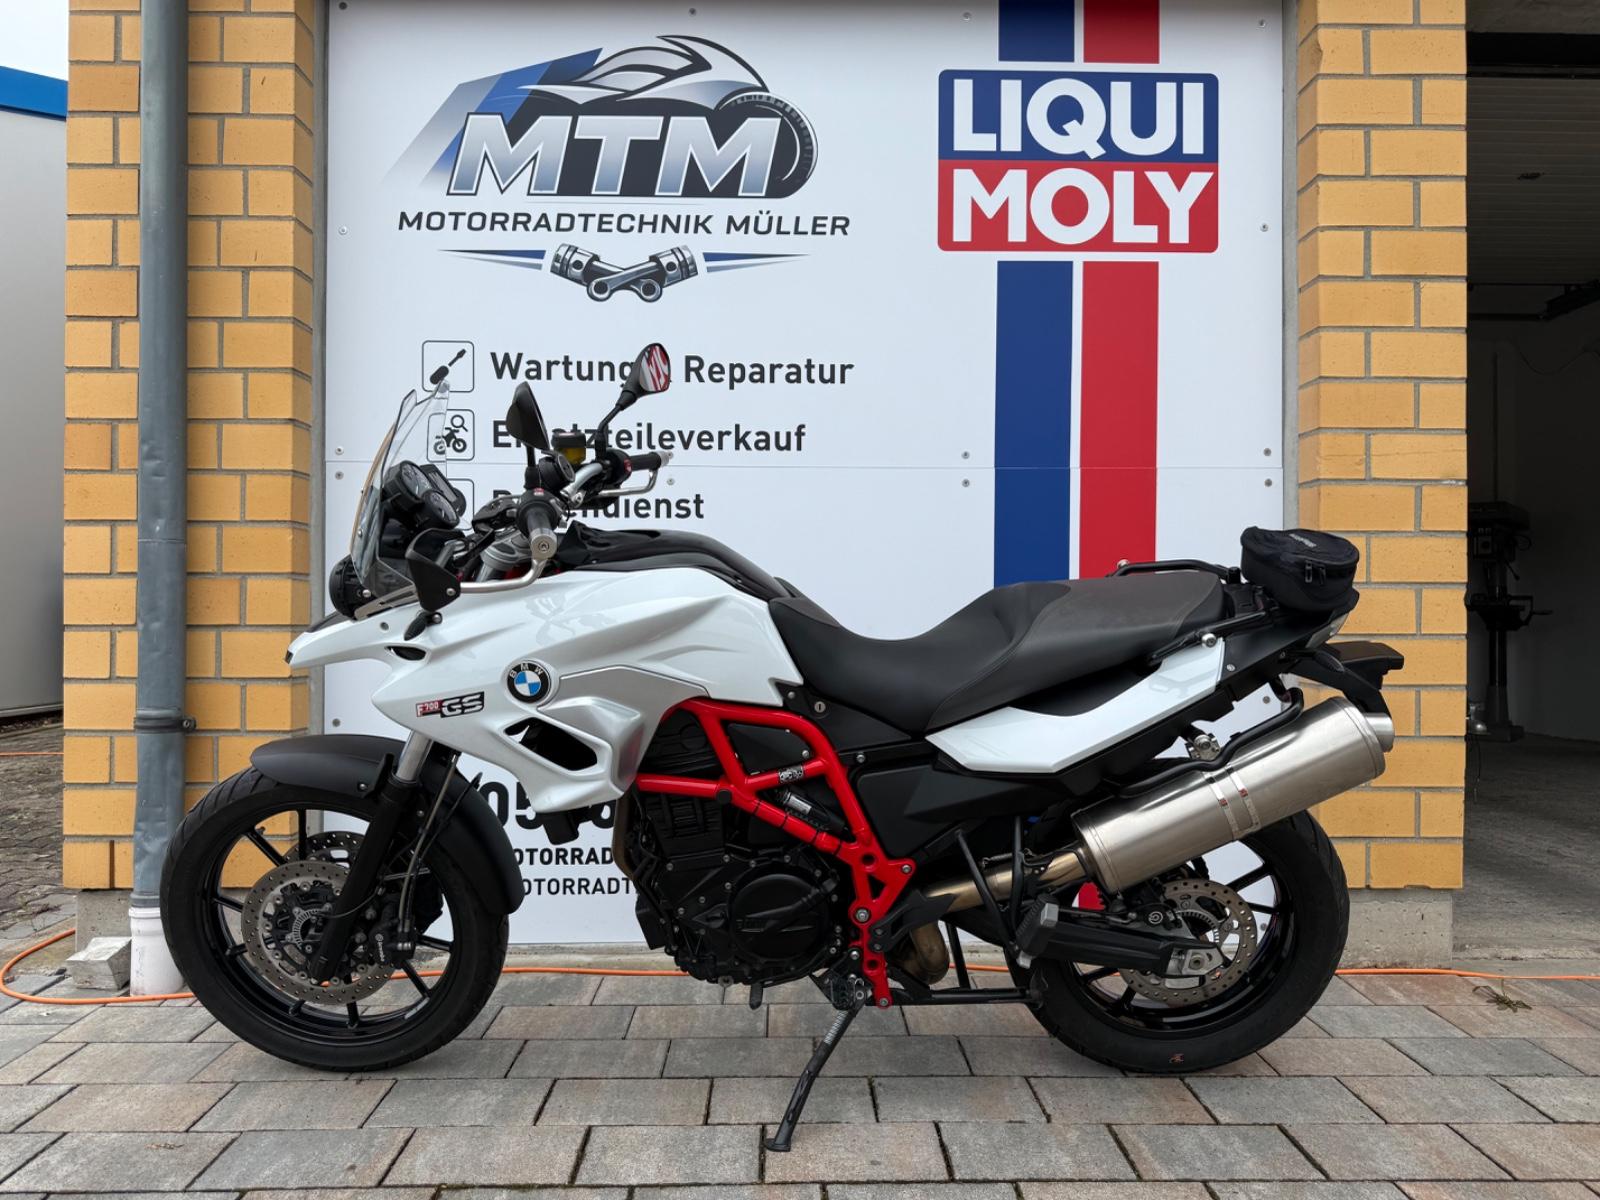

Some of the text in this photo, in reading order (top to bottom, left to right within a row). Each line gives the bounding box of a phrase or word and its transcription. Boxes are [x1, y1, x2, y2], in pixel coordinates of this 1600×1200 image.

[954, 78, 1204, 159] LIQUI
[446, 112, 782, 197] MTM
[953, 167, 1214, 245] MOLY
[398, 210, 850, 236] MOTORRADTECHNIK MÜLLER
[685, 355, 855, 390] Reparatur
[441, 694, 483, 717] GS
[513, 847, 614, 866] OTORRAD
[523, 877, 634, 896] OTORRADT
